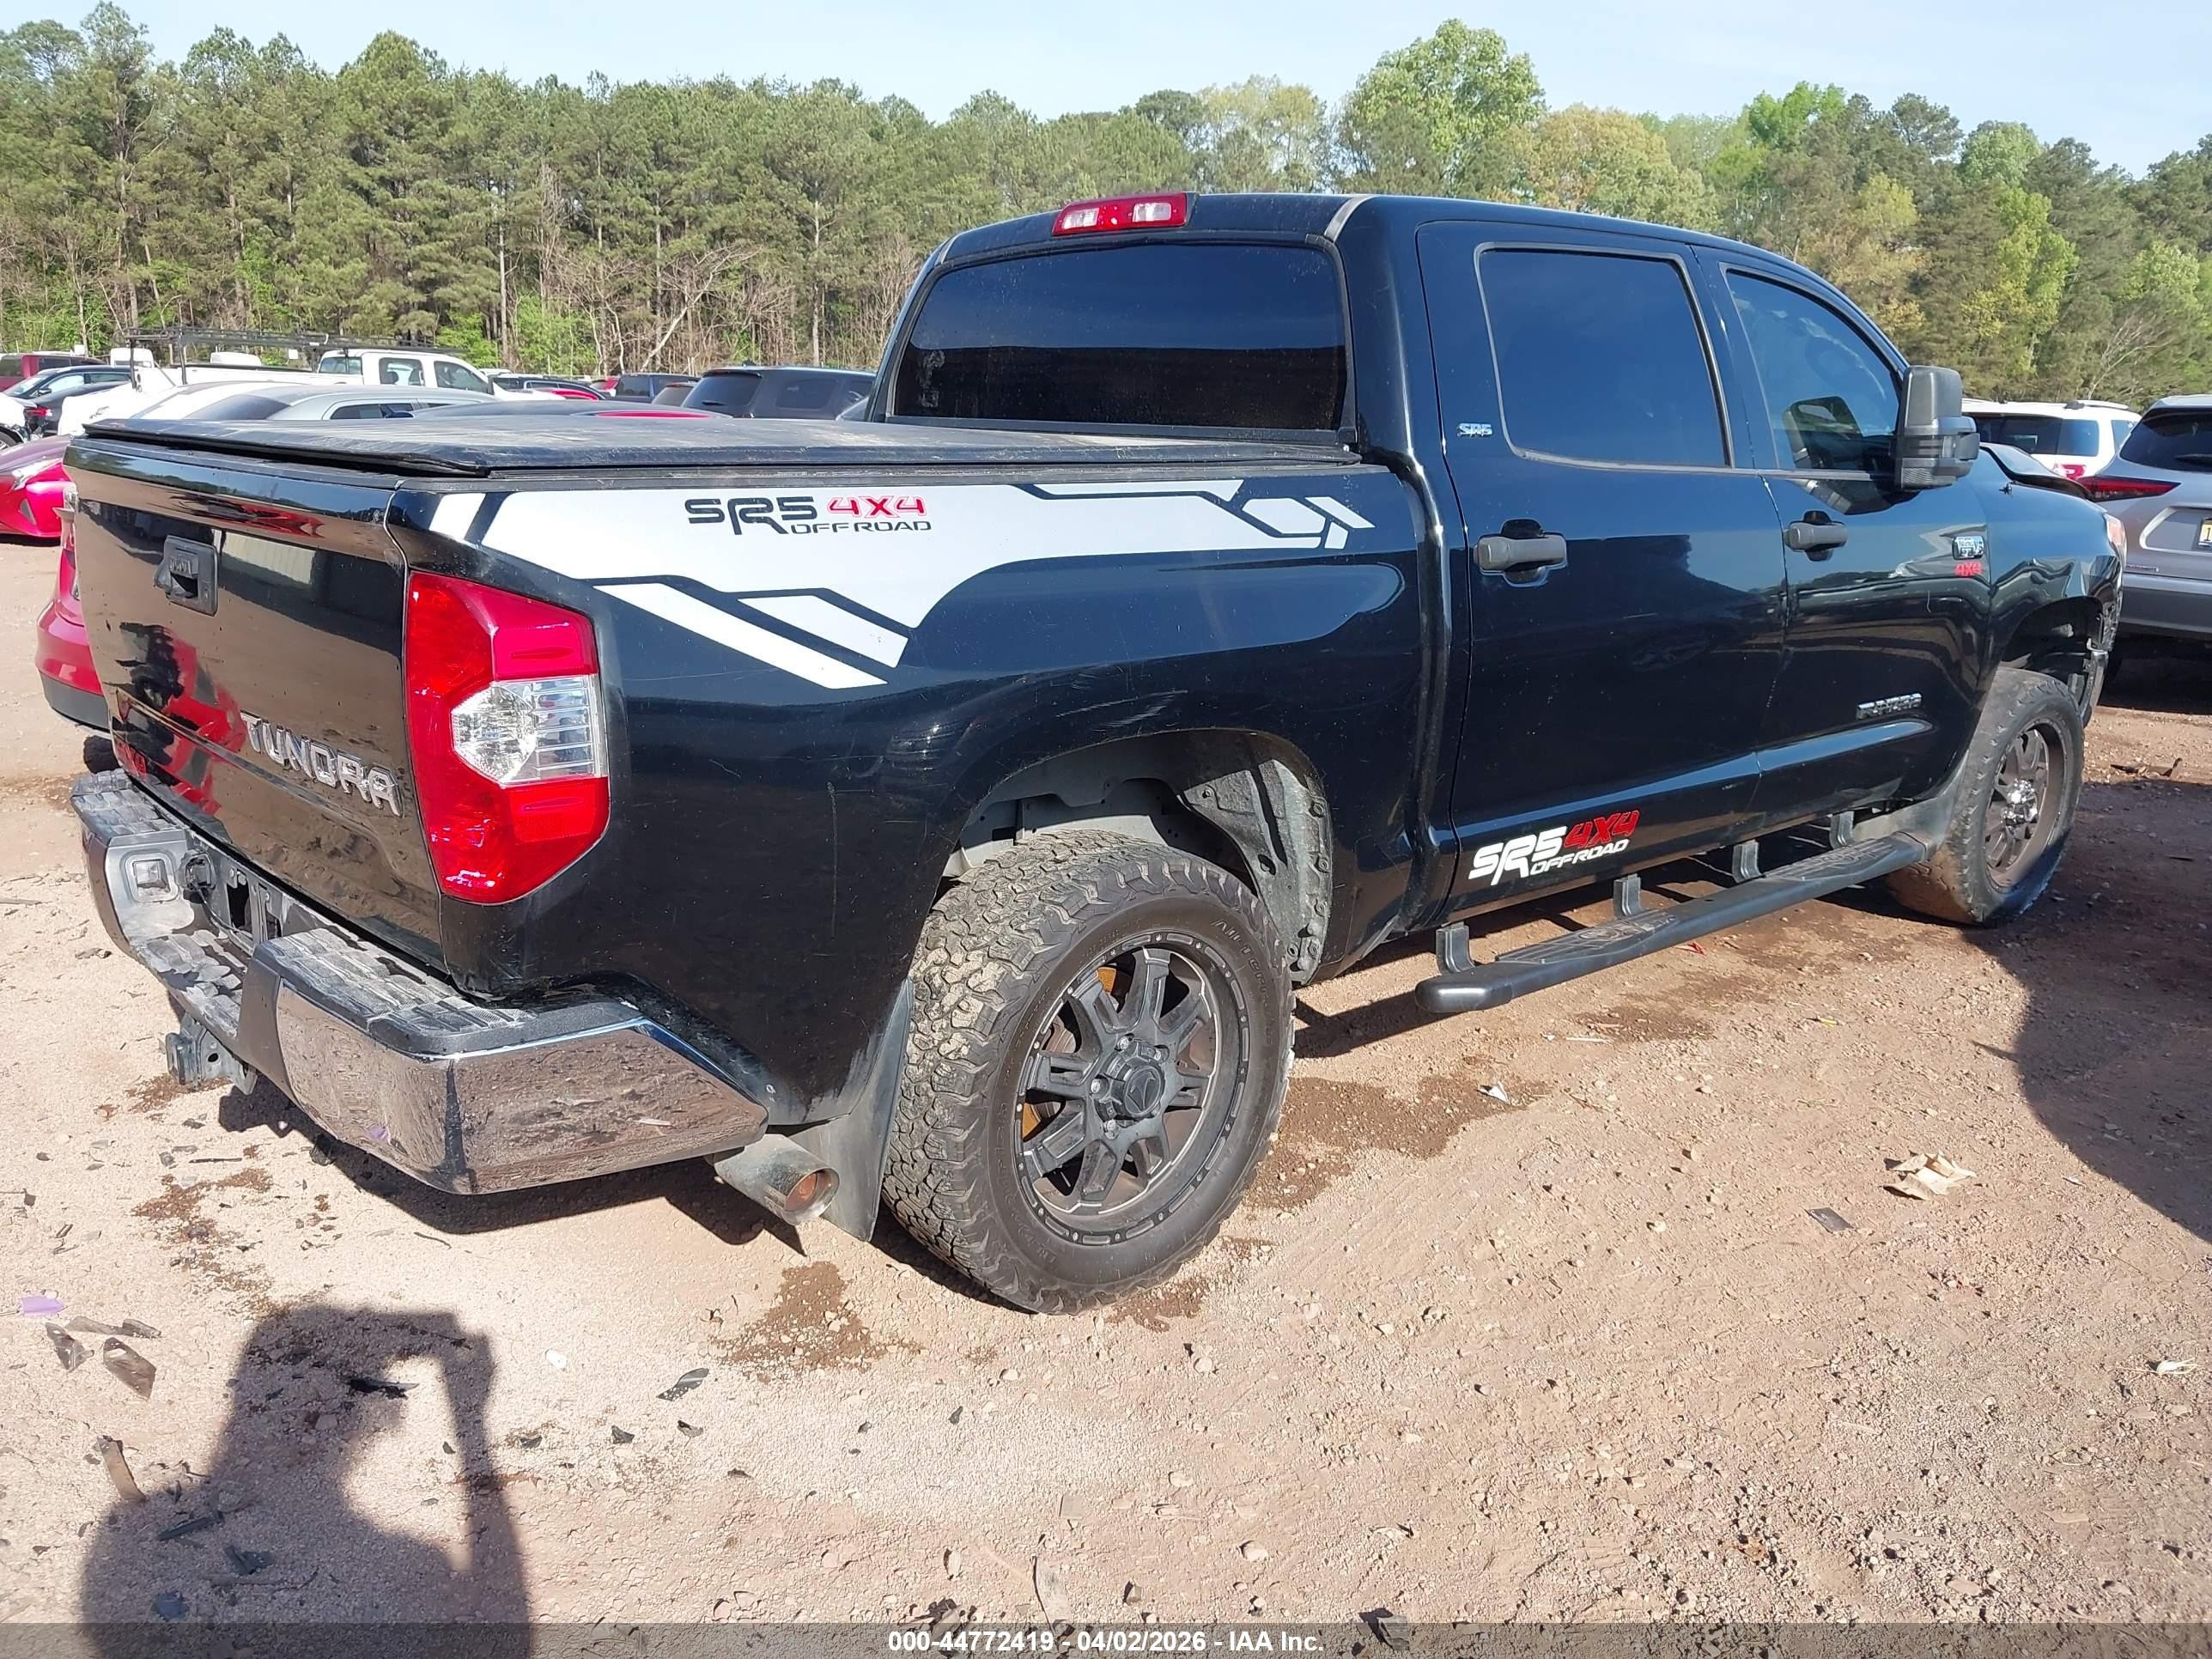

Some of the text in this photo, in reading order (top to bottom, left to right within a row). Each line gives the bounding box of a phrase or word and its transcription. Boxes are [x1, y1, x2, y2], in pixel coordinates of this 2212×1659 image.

[684, 495, 927, 535] SR5 4X4
[240, 709, 405, 817] TUNDRA
[1468, 826, 1568, 886] SR5
